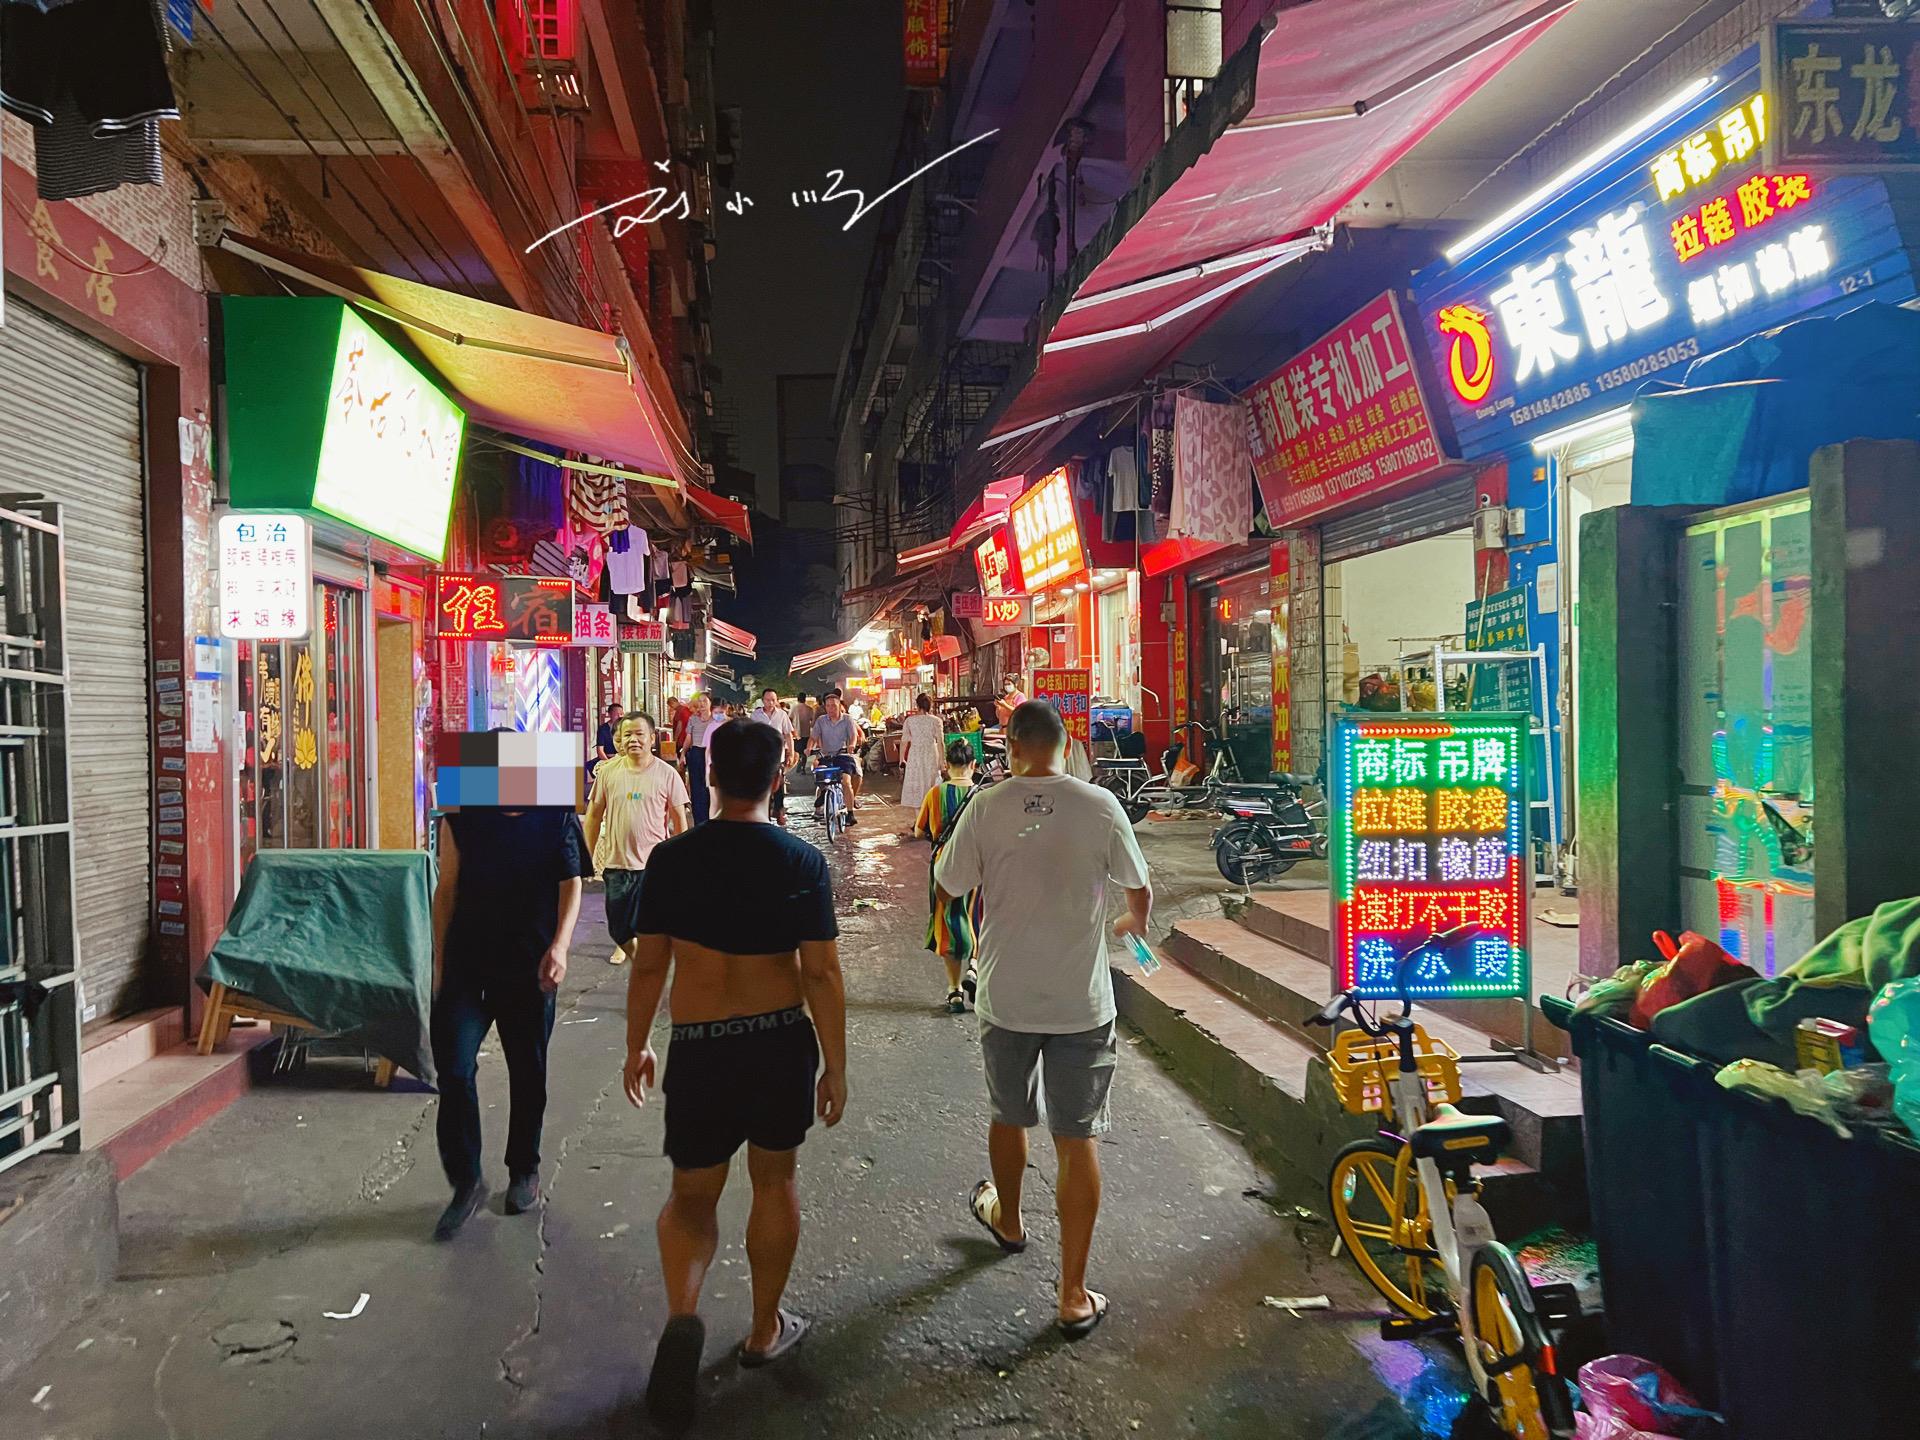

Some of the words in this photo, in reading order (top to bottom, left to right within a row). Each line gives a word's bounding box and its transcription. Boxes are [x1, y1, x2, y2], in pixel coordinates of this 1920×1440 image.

[1791, 42, 1901, 144] 东龙
[1651, 132, 1717, 202] 商标
[1671, 197, 1736, 262] 拉链
[1490, 203, 1670, 383] 東龍
[1839, 270, 1874, 295] 12-1
[1596, 337, 1699, 392] 13580285053
[236, 523, 287, 542] 包治
[984, 600, 1020, 621] 小炒
[1355, 738, 1427, 783] 商标
[1438, 738, 1507, 783] 吊牌
[1357, 788, 1427, 831] 拉链
[1437, 788, 1507, 831] 胶袋
[1357, 838, 1427, 881] 纽扣
[1438, 837, 1507, 881] 橡筋
[1358, 888, 1508, 938] 速打不干胶
[711, 1013, 778, 1037] DGYM
